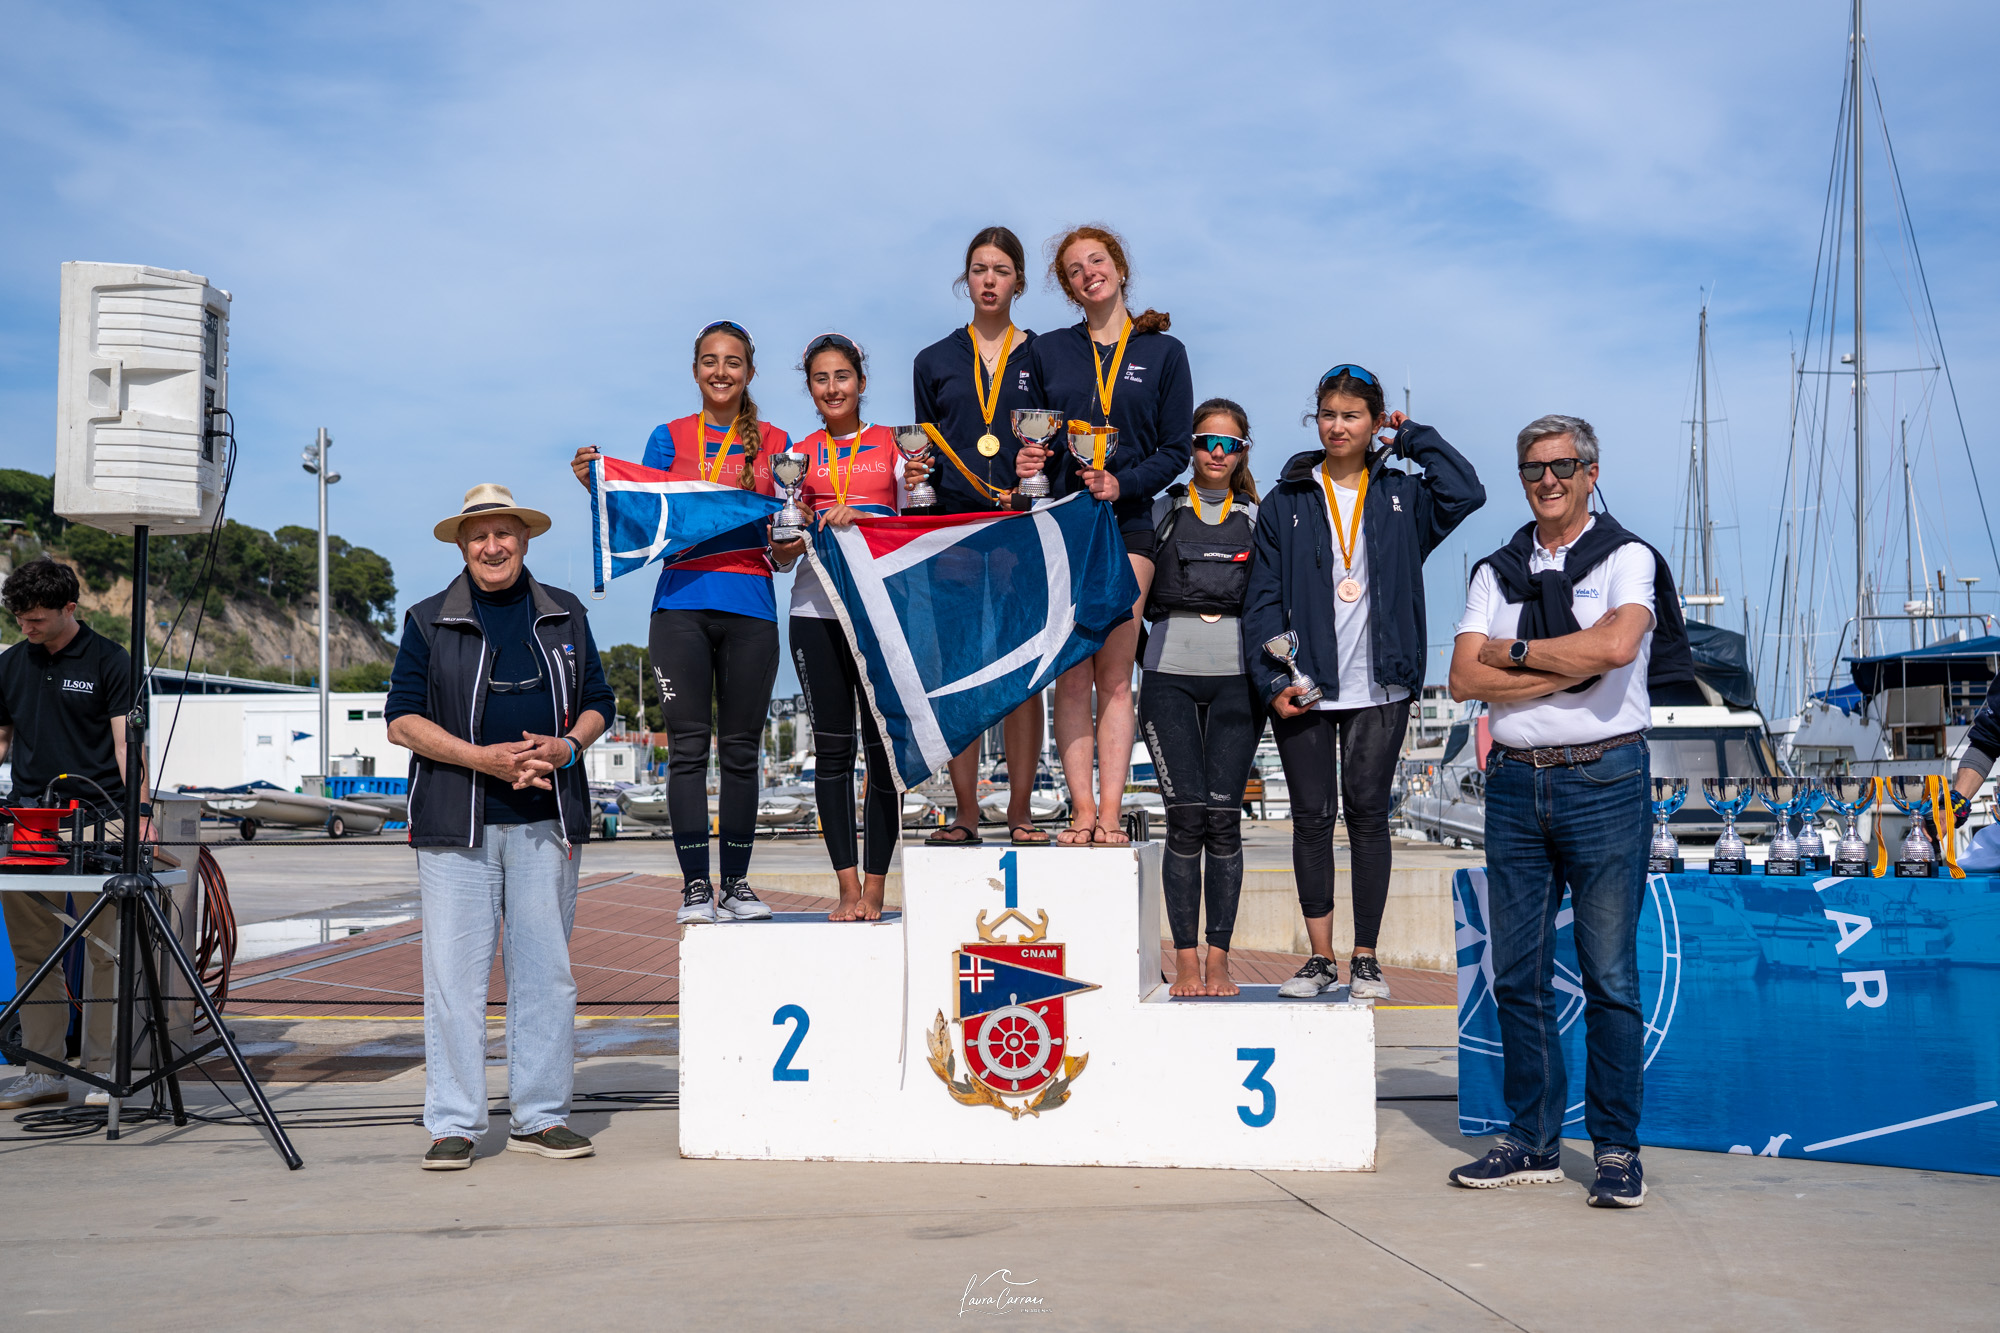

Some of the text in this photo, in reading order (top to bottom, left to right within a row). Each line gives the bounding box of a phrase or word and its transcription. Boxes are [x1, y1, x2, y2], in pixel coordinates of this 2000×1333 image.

[736, 464, 769, 479] BLÍS
[852, 461, 886, 474] BALÍS
[63, 679, 95, 690] ILSON
[654, 666, 676, 703] zhik
[999, 851, 1018, 908] 1
[1021, 949, 1057, 958] CNAM
[772, 1004, 810, 1082] 2
[1236, 1047, 1277, 1128] 3
